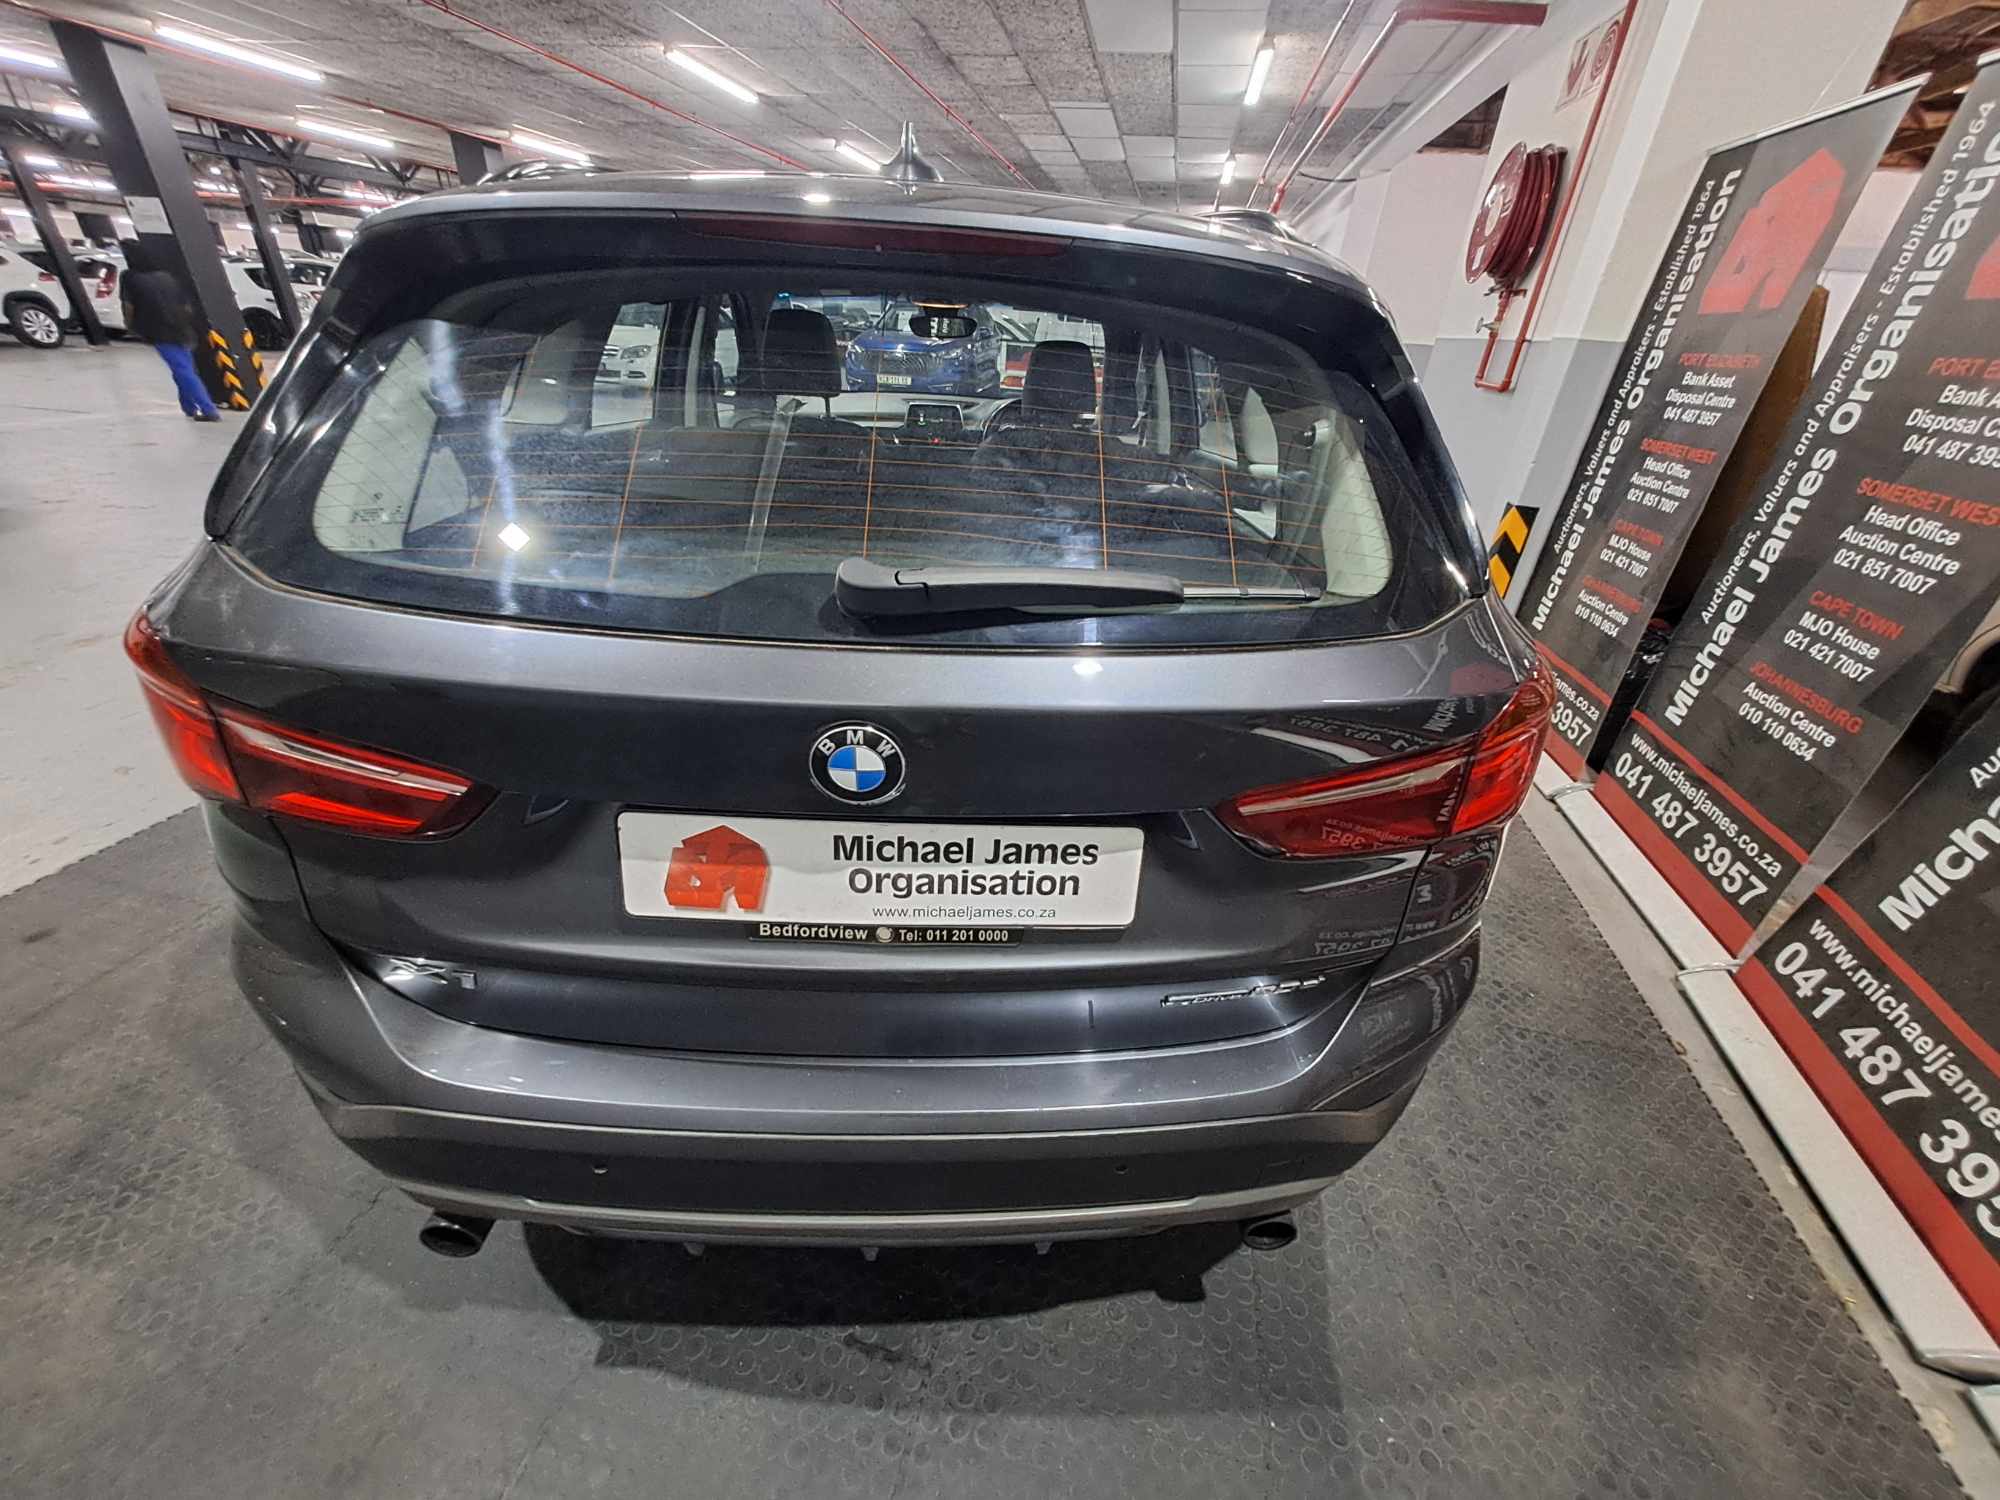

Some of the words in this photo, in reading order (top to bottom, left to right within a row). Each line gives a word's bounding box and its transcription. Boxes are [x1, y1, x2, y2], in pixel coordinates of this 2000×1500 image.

[1554, 482, 1588, 552] Auctioneers,
[1584, 430, 1610, 476] Valuers
[1607, 398, 1623, 427] and
[1618, 322, 1655, 397] Appraisers
[1654, 224, 1697, 310] Established
[1692, 180, 1715, 218] 1964
[1682, 371, 1708, 386] Bank
[1707, 373, 1736, 388] Asset
[1701, 529, 1761, 624] Auctioneers,
[1754, 459, 1797, 522] Valuers
[1795, 418, 1819, 456] and
[1814, 314, 1880, 417] Appraisers
[1879, 169, 1958, 295] Established
[1953, 100, 1996, 161] 1964
[1928, 357, 1986, 378] PORT
[1531, 524, 1585, 631] Michael
[1582, 419, 1631, 520] James
[1627, 168, 1742, 410] Organisation
[1663, 406, 1682, 420] 041
[1665, 388, 1707, 405] Disposal
[1705, 392, 1736, 408] Centre
[1937, 384, 1989, 408] Bank
[1905, 408, 1983, 435] Disposal
[1643, 457, 1669, 473] Head
[1667, 462, 1691, 479] Office
[1902, 434, 1938, 456] 041
[1935, 439, 1972, 461] 487
[1968, 445, 2000, 468] 395
[1627, 488, 1644, 502] 021
[1630, 472, 1663, 490] Auction
[1662, 480, 1690, 499] Centre
[1856, 477, 1951, 513] SOMERSET
[1949, 500, 2000, 526] WES
[1863, 504, 1907, 532] Head
[1906, 516, 1960, 546] Office
[1600, 549, 1616, 564] 021
[1613, 555, 1629, 570] 421
[1608, 534, 1629, 551] MJO
[1626, 542, 1652, 562] House
[1838, 524, 1899, 557] Auction
[1899, 541, 1960, 577] Centre
[1664, 586, 1755, 727] Michael
[1749, 448, 1837, 584] James
[1832, 548, 1864, 570] 021
[1861, 557, 1890, 580] 851
[1889, 566, 1938, 595] 7007
[1574, 604, 1589, 620] 010
[1578, 589, 1606, 612] Auction
[1604, 603, 1629, 626] Centre
[1808, 590, 1854, 619] CAPE
[1851, 605, 1904, 641] TOWN
[1783, 628, 1812, 652] 021
[1808, 639, 1837, 665] 421
[1834, 651, 1875, 684] 7007
[1797, 610, 1834, 636] MJO
[1831, 625, 1881, 661] House
[1743, 681, 1790, 720] Auction
[1790, 710, 1837, 749] Centre
[1751, 663, 1864, 735] JOHANNESBURG
[1551, 701, 1592, 746] 3957
[1738, 702, 1760, 726] 010
[1762, 715, 1784, 741] 110
[1781, 732, 1817, 763] 0634
[1630, 733, 1783, 879] www.michaeljames.co.za
[832, 834, 974, 864] Michael
[985, 838, 1099, 866] James
[1615, 752, 1654, 800] 041
[1651, 792, 1699, 839] 487
[1694, 833, 1769, 906] 3957
[848, 868, 1080, 898] Organisation
[1878, 795, 2000, 932] Mich
[759, 922, 868, 941] Bedfordview
[899, 929, 923, 942] Tel:
[927, 929, 949, 942] 011
[952, 929, 975, 942] 201
[978, 930, 1008, 943] 0000
[872, 904, 1056, 921] www.michaeljames.co.za
[1773, 941, 1846, 1020] 041
[1839, 1026, 1934, 1107] 487
